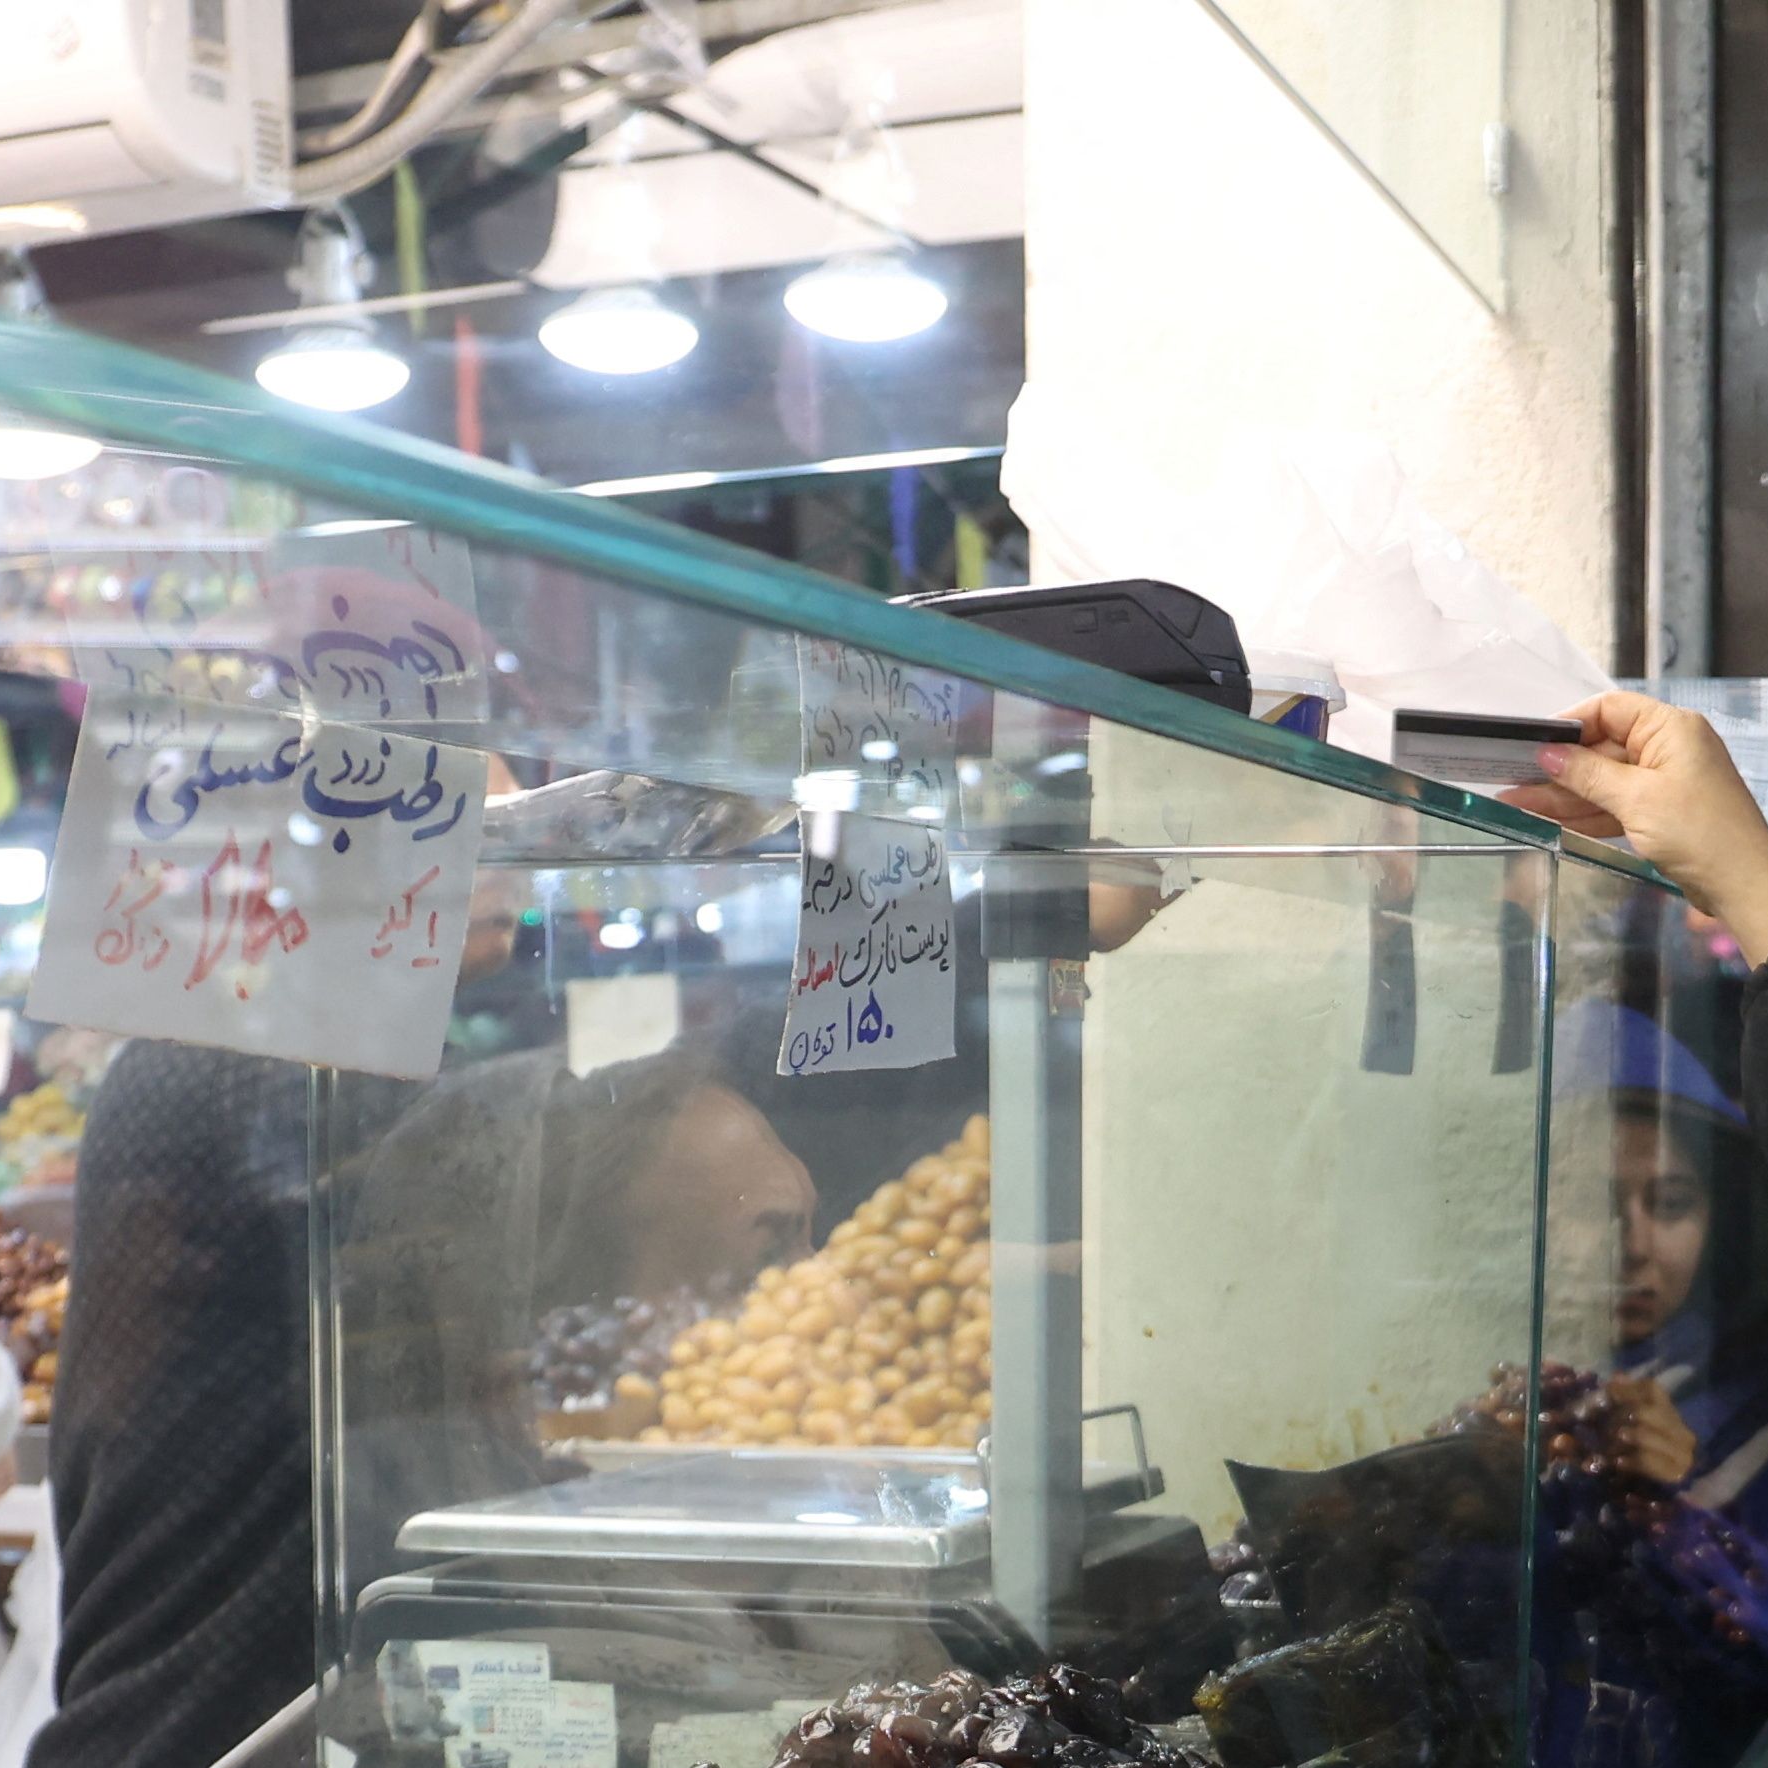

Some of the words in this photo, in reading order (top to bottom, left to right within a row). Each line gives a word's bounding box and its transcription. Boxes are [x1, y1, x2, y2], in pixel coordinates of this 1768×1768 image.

[134, 723, 314, 841] عسلی
[301, 744, 467, 854] رطب
[906, 830, 944, 893] رطب
[847, 988, 894, 1053] ۱۵۰
